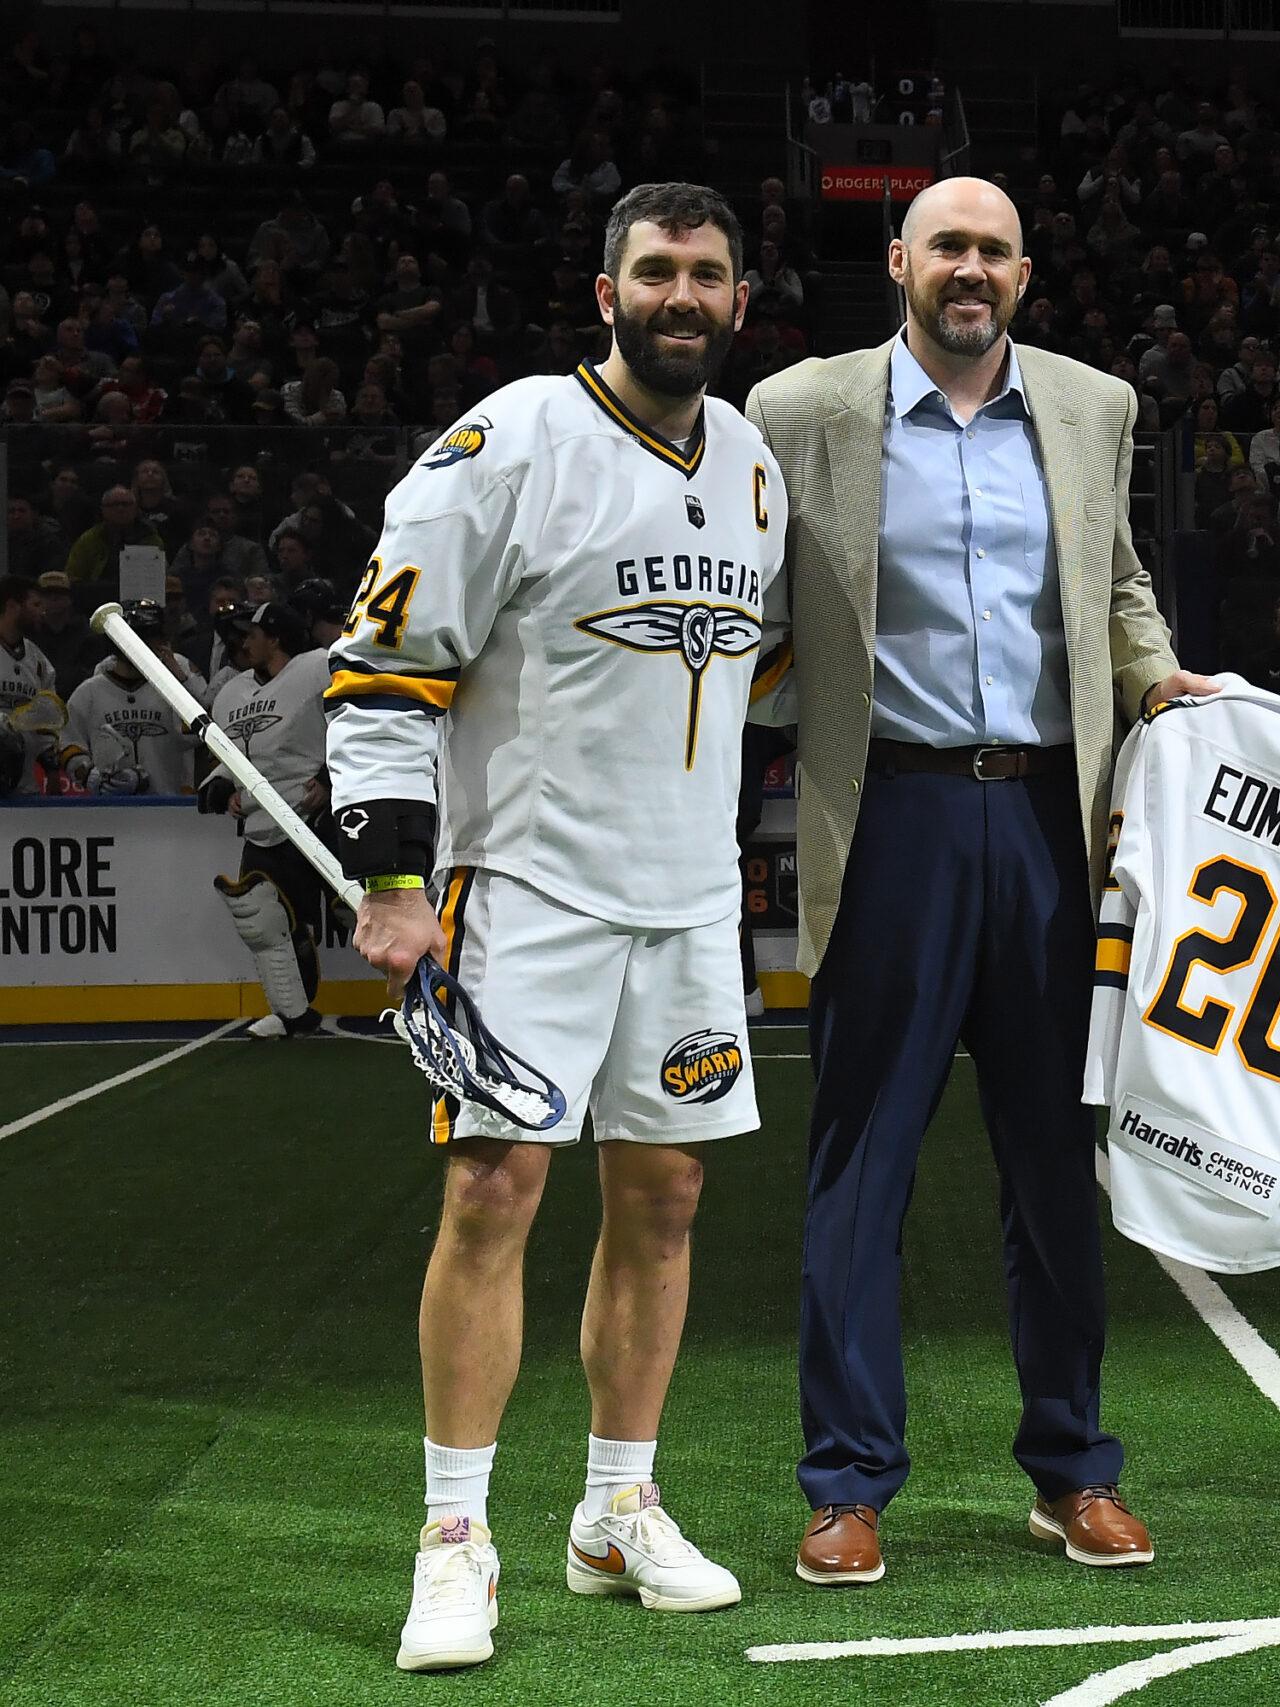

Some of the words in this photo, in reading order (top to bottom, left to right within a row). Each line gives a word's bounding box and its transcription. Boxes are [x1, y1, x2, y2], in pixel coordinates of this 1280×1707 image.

[753, 462, 768, 533] C
[341, 556, 422, 650] 24
[615, 554, 759, 607] GEORGIA
[105, 709, 162, 724] GEORGIA
[228, 699, 277, 723] GEORGIA
[0, 836, 116, 899] ORE
[2, 904, 117, 955] NTON
[664, 1049, 740, 1094] SWARM
[1205, 1163, 1271, 1199] CASINOS
[1210, 1152, 1278, 1189] CHEROKEE
